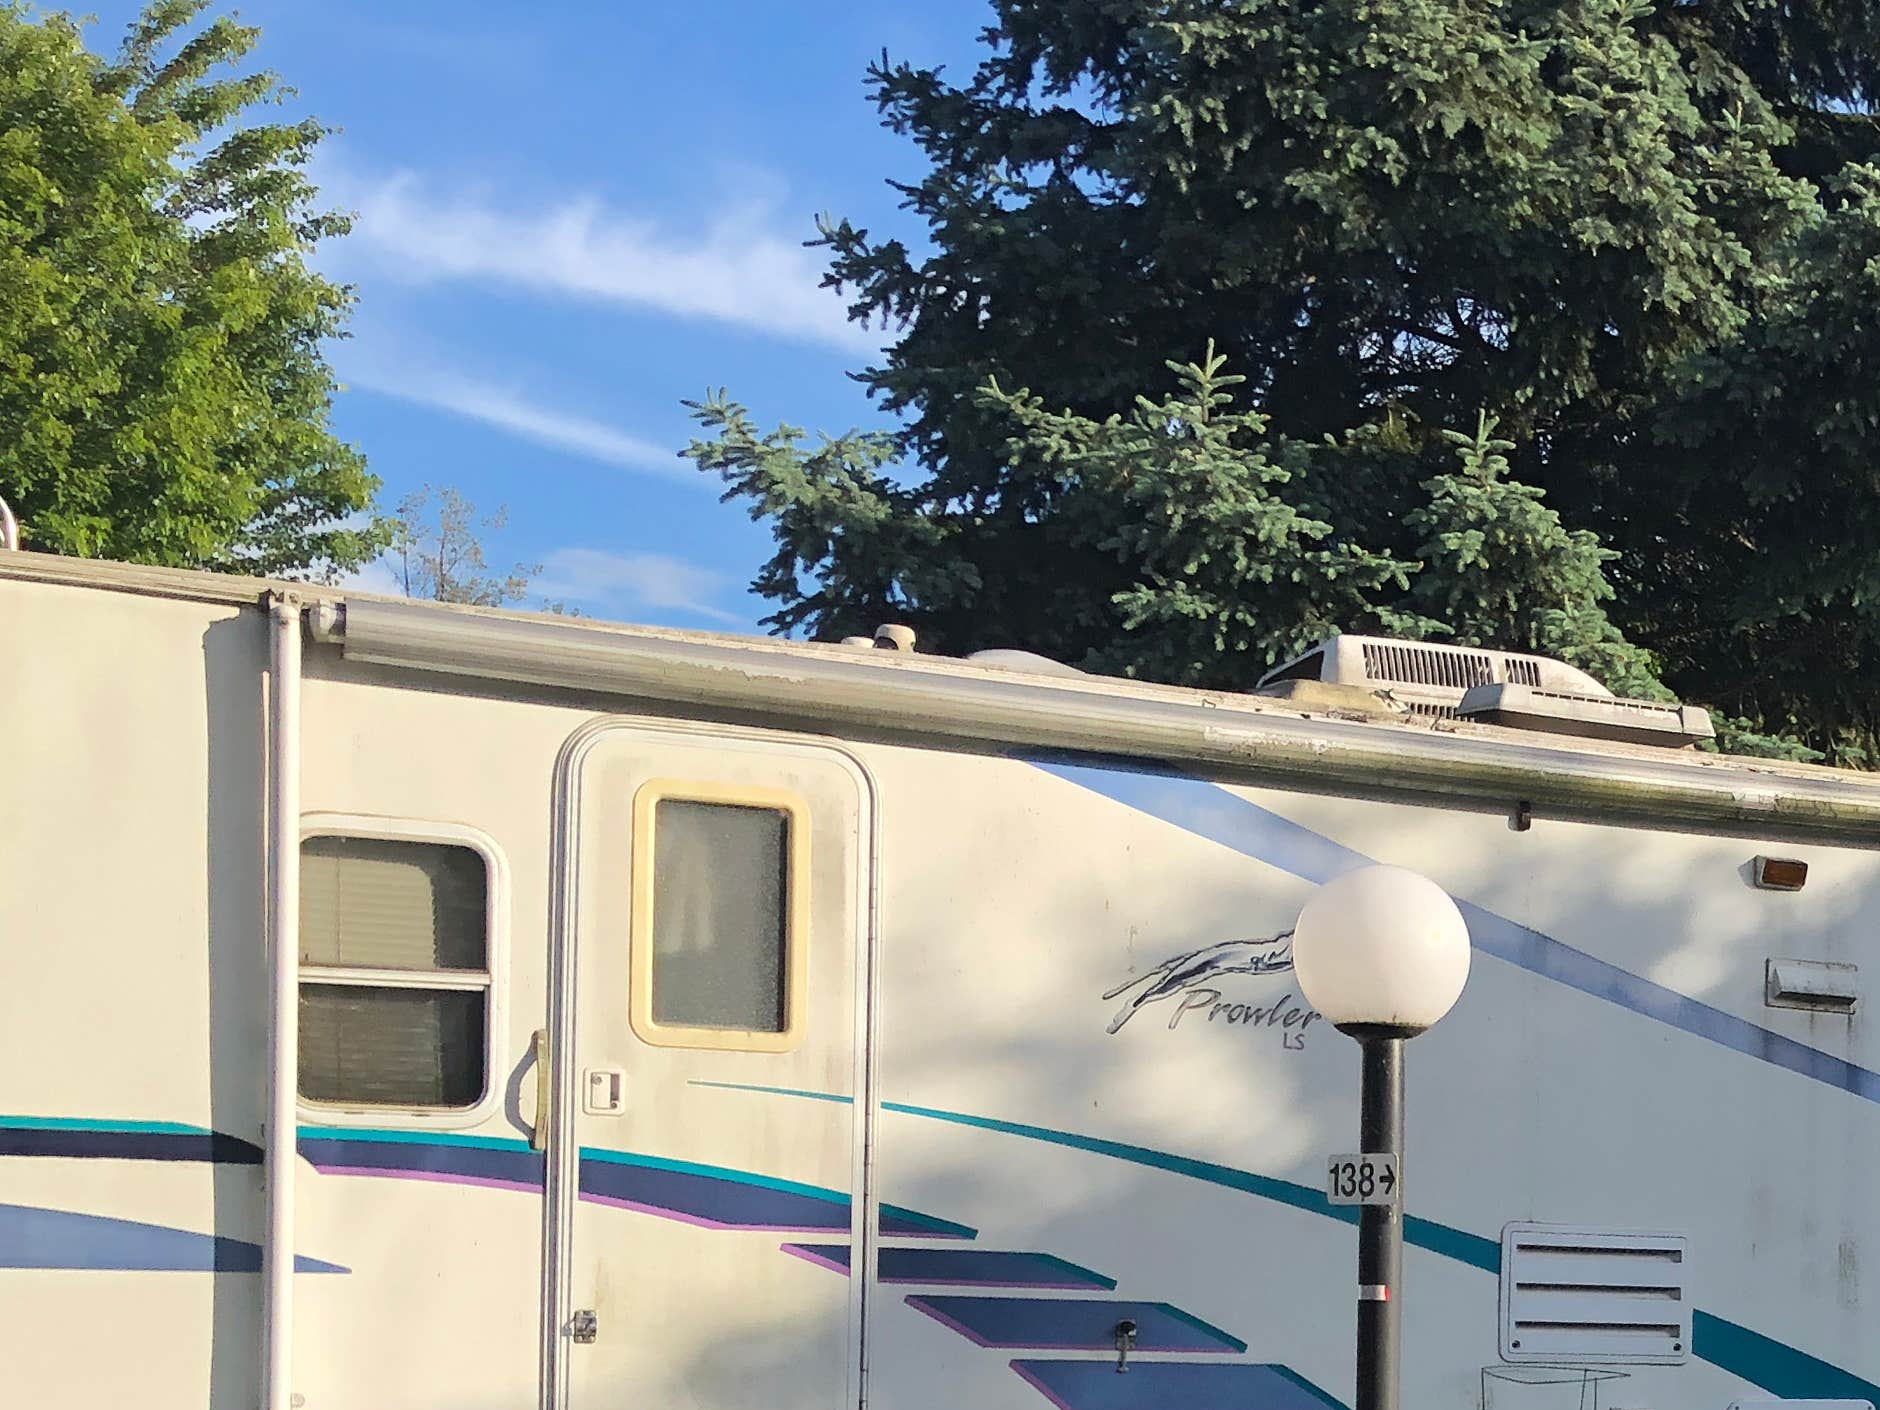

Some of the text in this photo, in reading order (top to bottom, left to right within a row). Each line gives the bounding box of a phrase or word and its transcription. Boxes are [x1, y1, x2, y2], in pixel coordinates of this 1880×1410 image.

[1168, 988, 1322, 1030] Prowler
[1283, 1032, 1305, 1050] LS
[1329, 1162, 1375, 1197] 138
